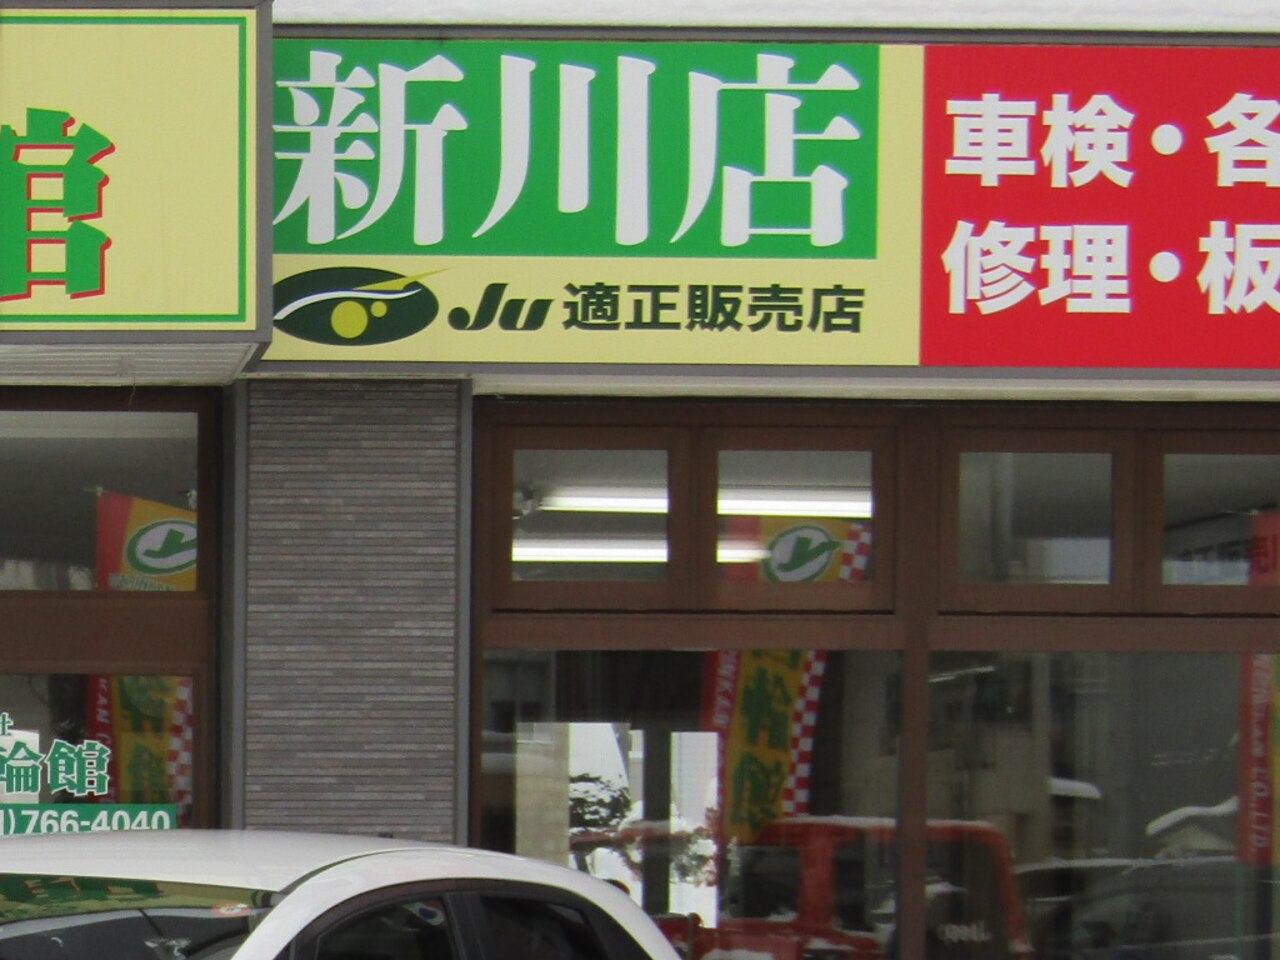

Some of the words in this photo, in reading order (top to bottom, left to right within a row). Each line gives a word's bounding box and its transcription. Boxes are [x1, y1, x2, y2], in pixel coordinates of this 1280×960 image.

[272, 49, 861, 247] 新川店
[945, 92, 1280, 188] 車検・各
[562, 281, 866, 335] 適正販売店
[941, 219, 1280, 315] 修理・板
